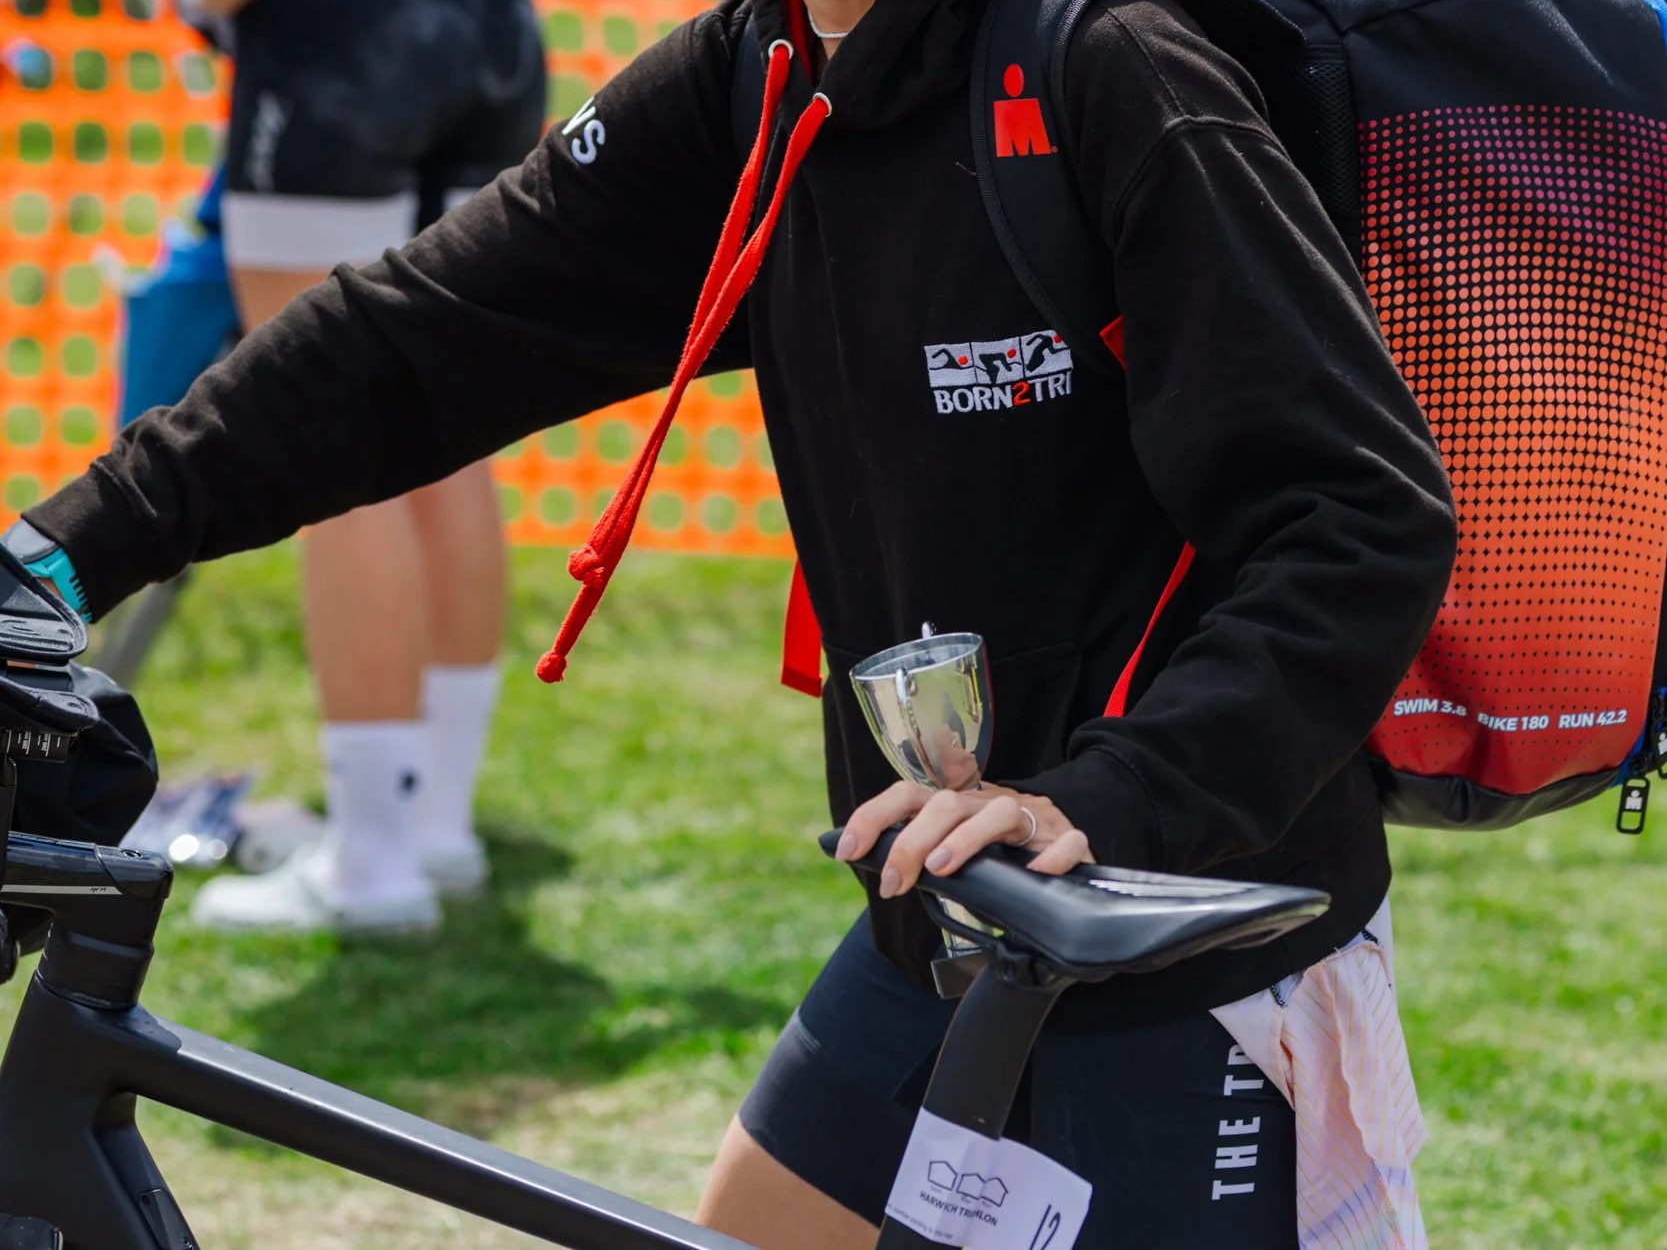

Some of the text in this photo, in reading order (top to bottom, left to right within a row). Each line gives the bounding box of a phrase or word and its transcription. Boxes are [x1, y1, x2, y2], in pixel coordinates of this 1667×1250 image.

[933, 371, 1073, 415] BORN2TRI
[1393, 698, 1629, 732] SWIM 3.8 BIKE 180 RUN 42.2
[1211, 1116, 1262, 1201] THE
